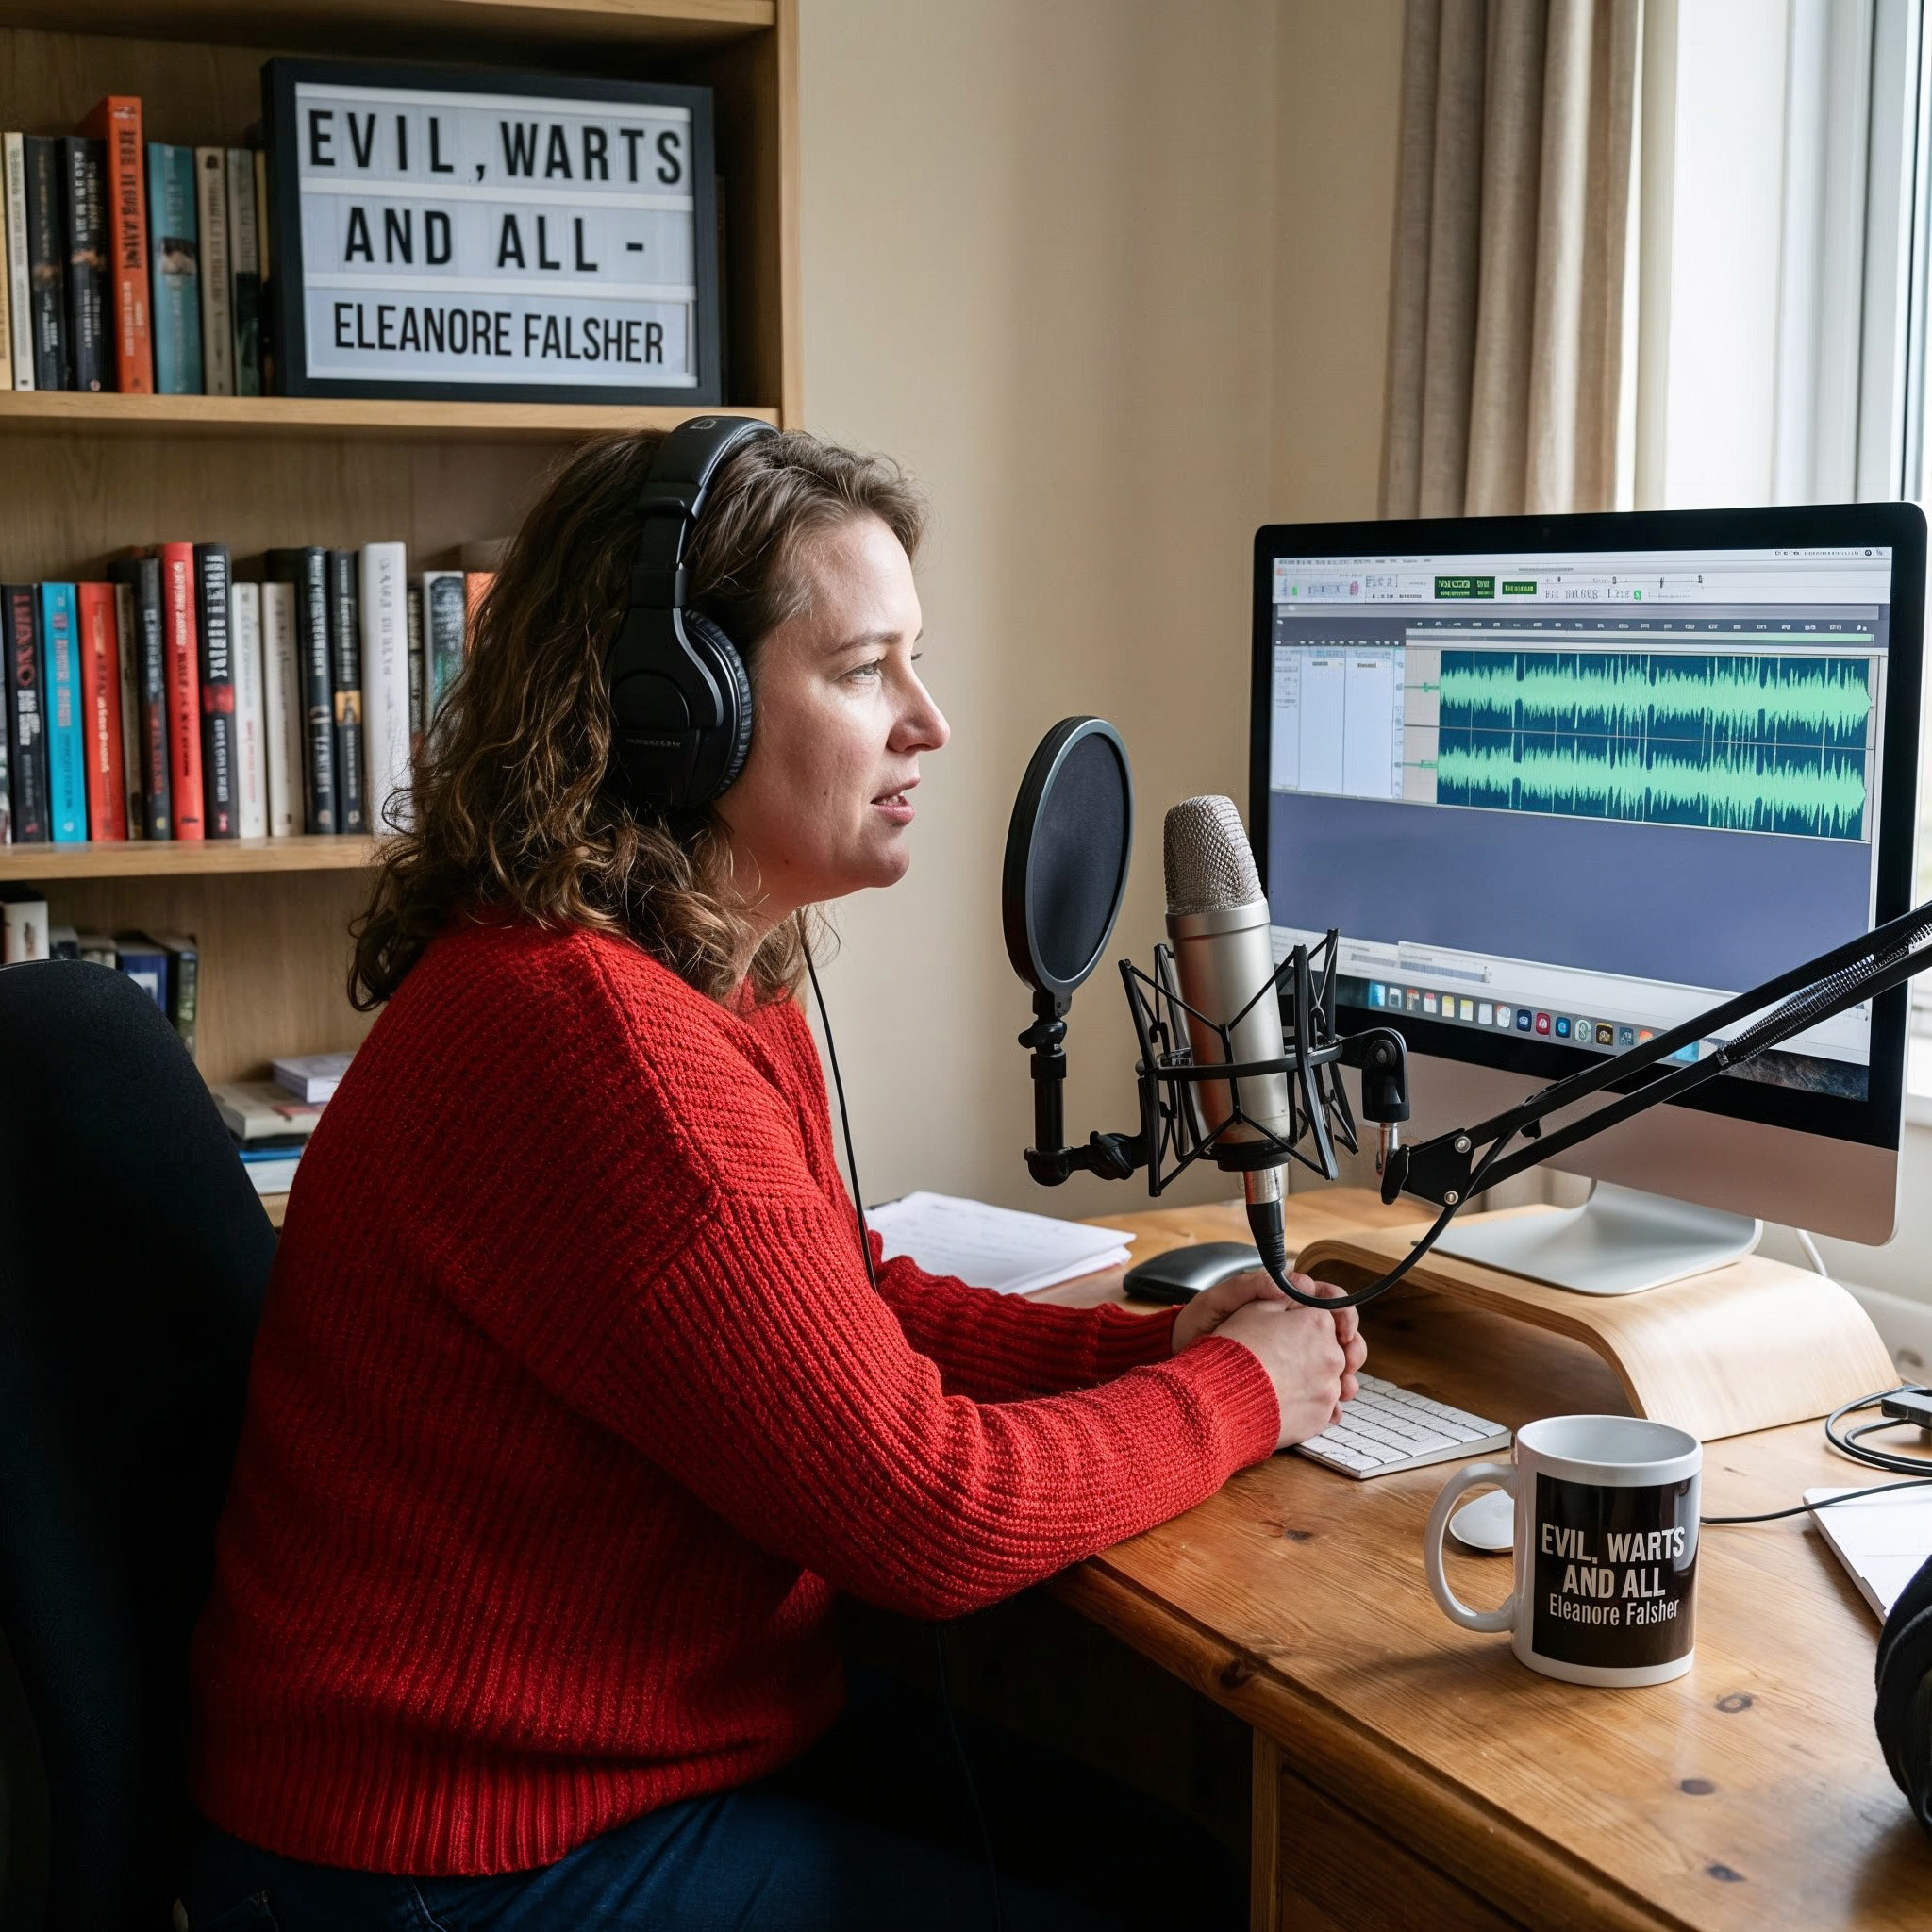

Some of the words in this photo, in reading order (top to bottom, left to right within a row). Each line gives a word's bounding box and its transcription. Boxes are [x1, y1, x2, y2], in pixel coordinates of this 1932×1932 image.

[500, 120, 684, 186] WARTS
[343, 206, 453, 266] AND
[496, 213, 599, 273] ALL
[333, 301, 512, 357] ELEANORE
[524, 312, 664, 365] FALSHER
[1607, 1526, 1686, 1563] WARTS
[1562, 1564, 1615, 1599] AND
[1621, 1567, 1666, 1599] ALL
[1549, 1592, 1620, 1626] Eleanore
[1625, 1598, 1680, 1626] Falsher
